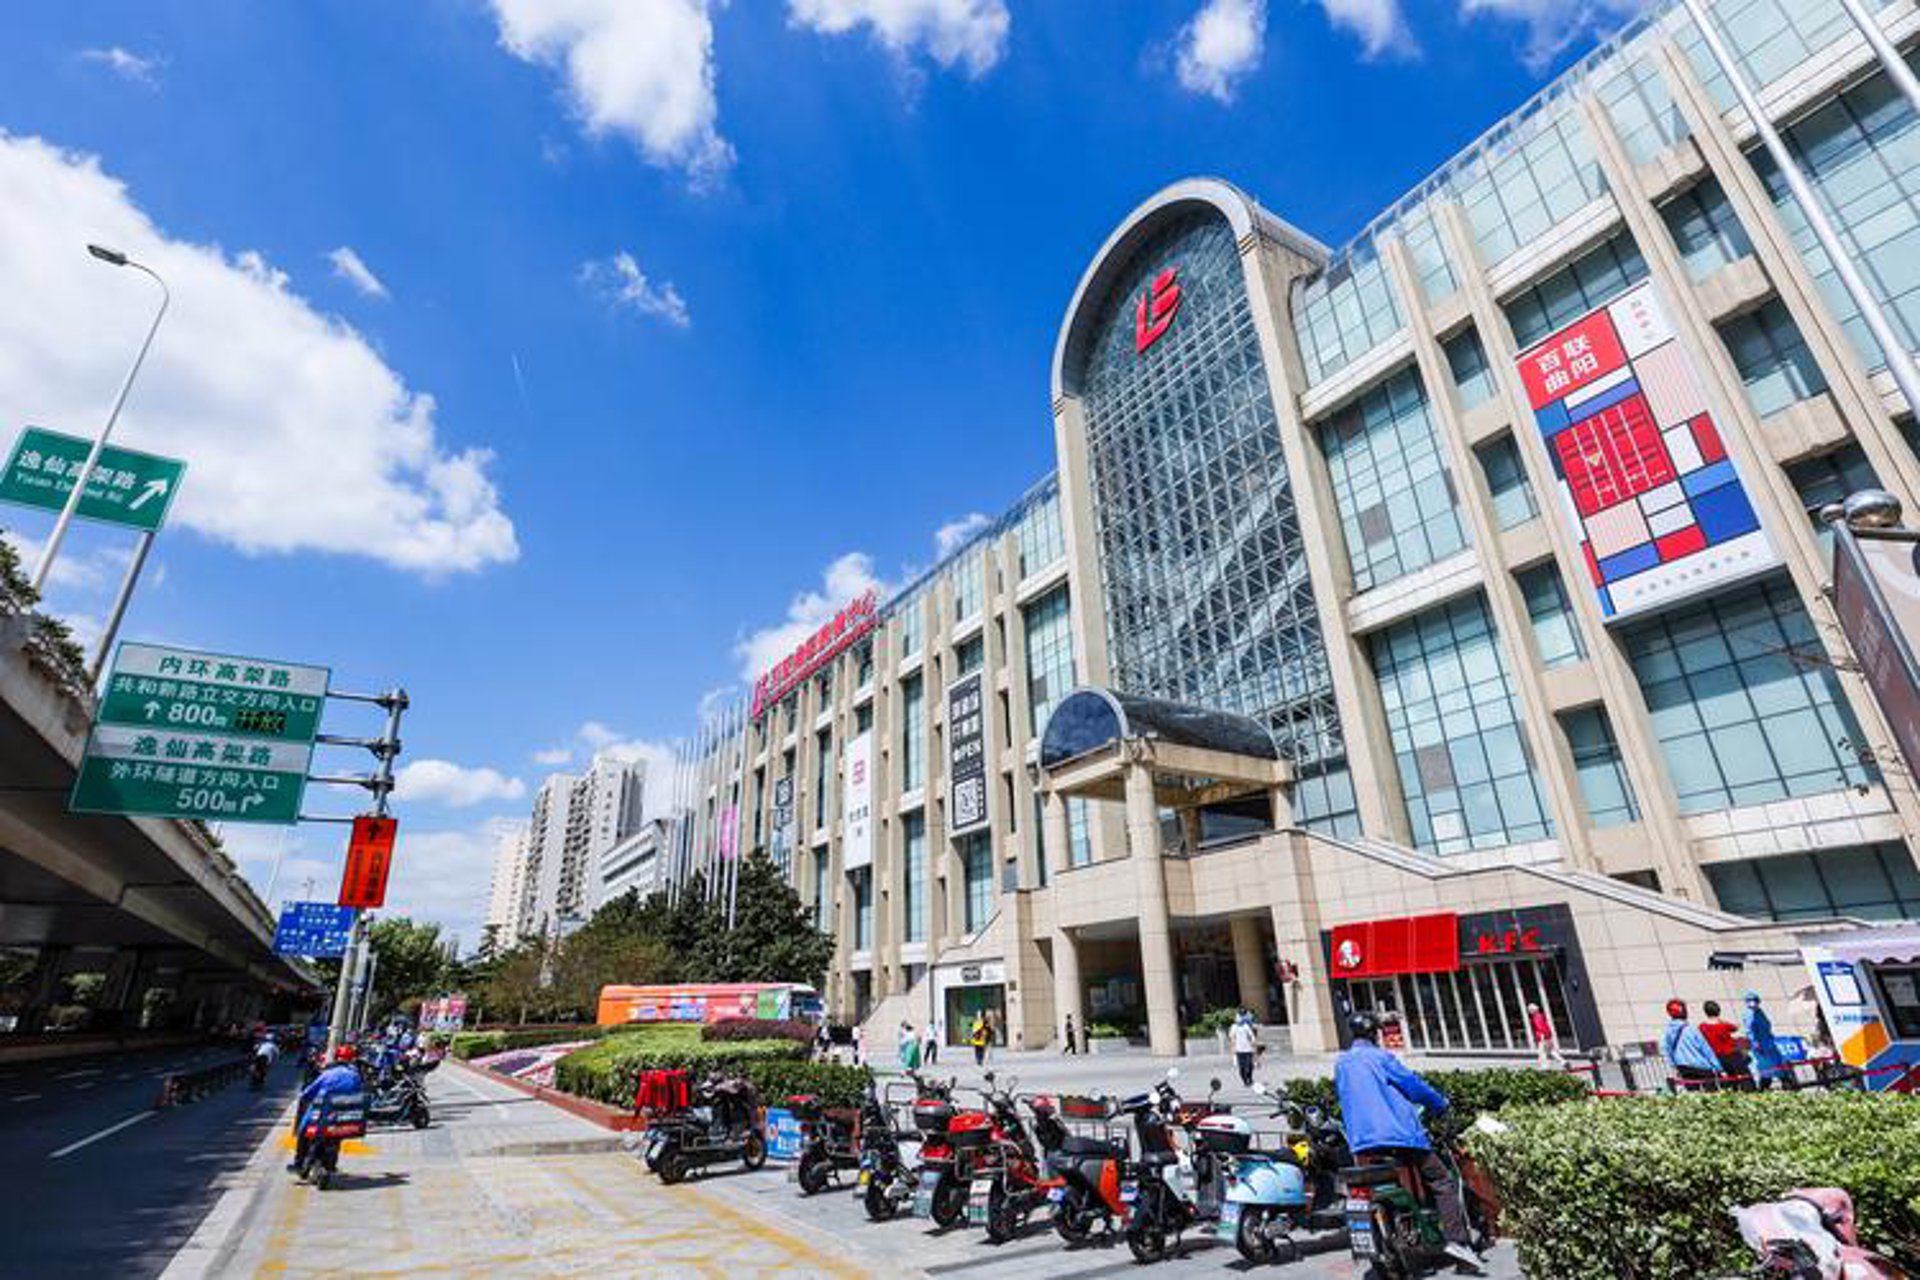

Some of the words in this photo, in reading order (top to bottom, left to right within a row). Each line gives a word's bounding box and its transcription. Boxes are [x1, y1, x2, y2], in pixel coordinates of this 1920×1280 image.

[1535, 334, 1592, 375] 百联
[1545, 352, 1598, 394] 曲阳
[158, 655, 291, 688] 内环高架路
[112, 676, 316, 713] 共和新路立交方向入口
[167, 703, 227, 727] 800m
[132, 735, 274, 765] 逸仙高架路
[109, 761, 281, 790] 外环隧道方向入口
[176, 787, 237, 813] 500m
[1479, 926, 1541, 953] KFC
